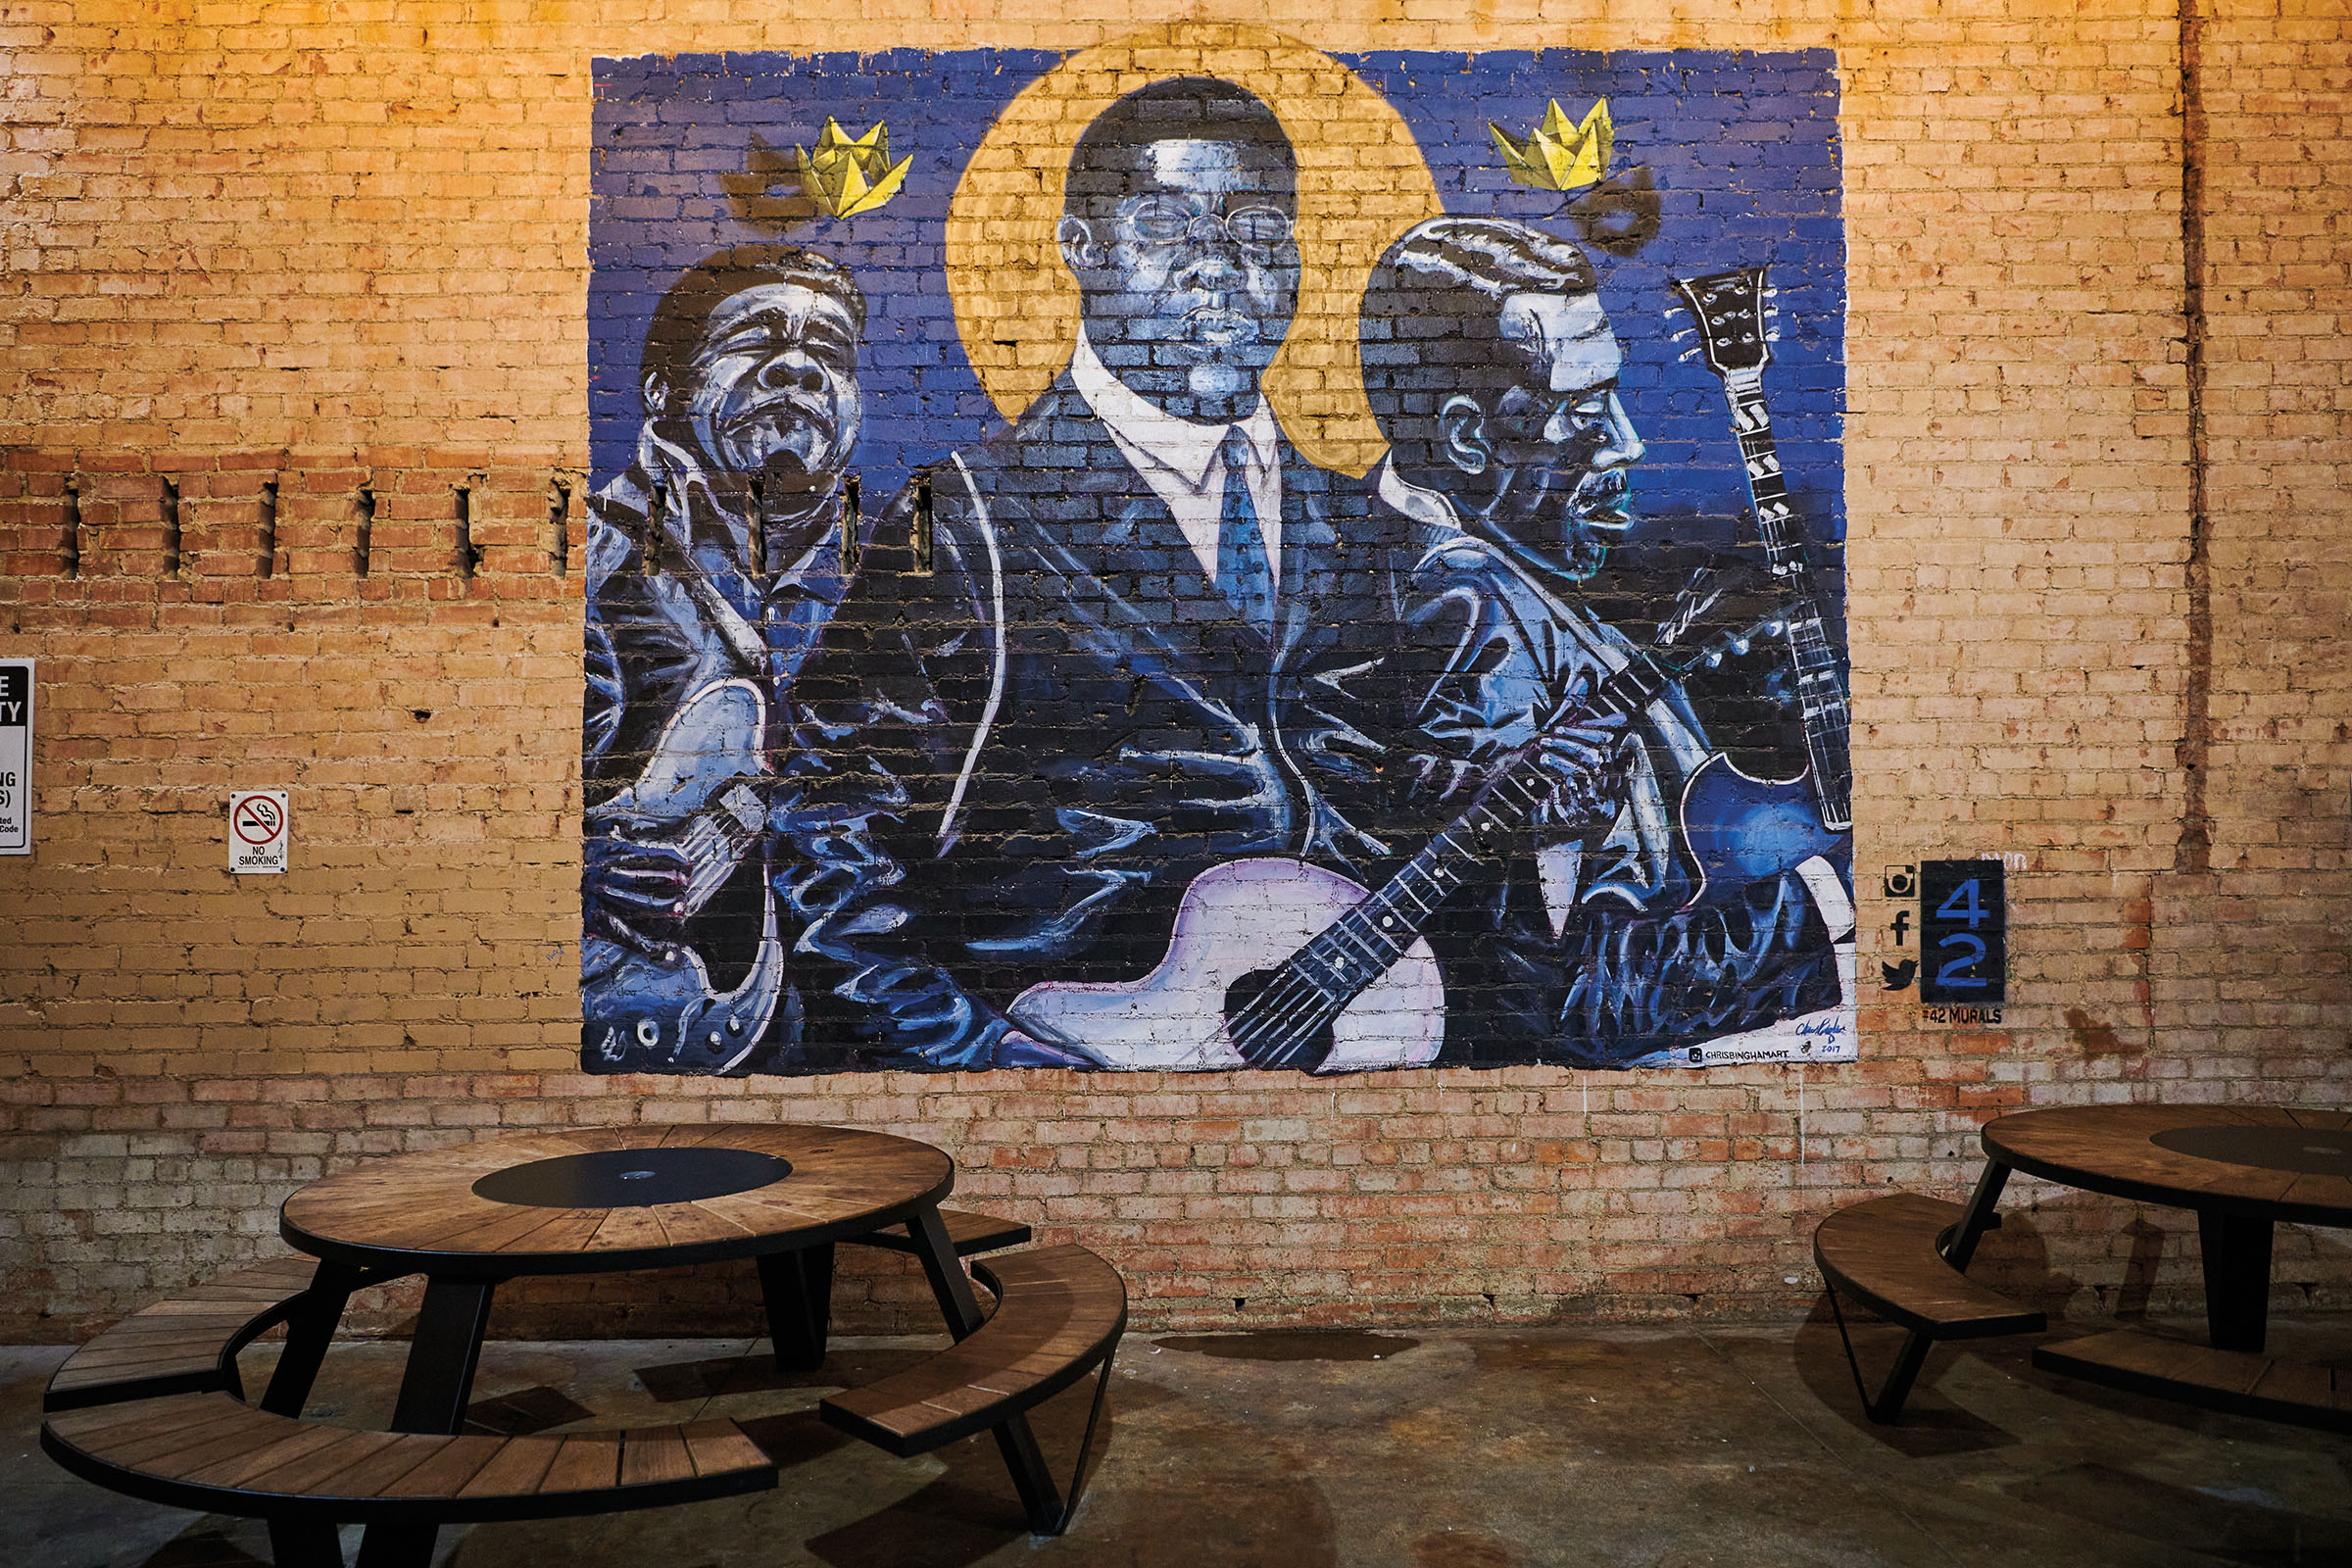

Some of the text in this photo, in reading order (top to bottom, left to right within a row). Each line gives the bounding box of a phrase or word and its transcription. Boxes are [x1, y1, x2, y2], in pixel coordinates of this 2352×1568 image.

[253, 846, 265, 855] NO
[239, 856, 278, 864] SMOKING
[1949, 1007, 2001, 1024] MURALS
[1822, 1045, 1840, 1054] 2017
[1705, 1050, 1788, 1060] CHRISBINGHAMART
